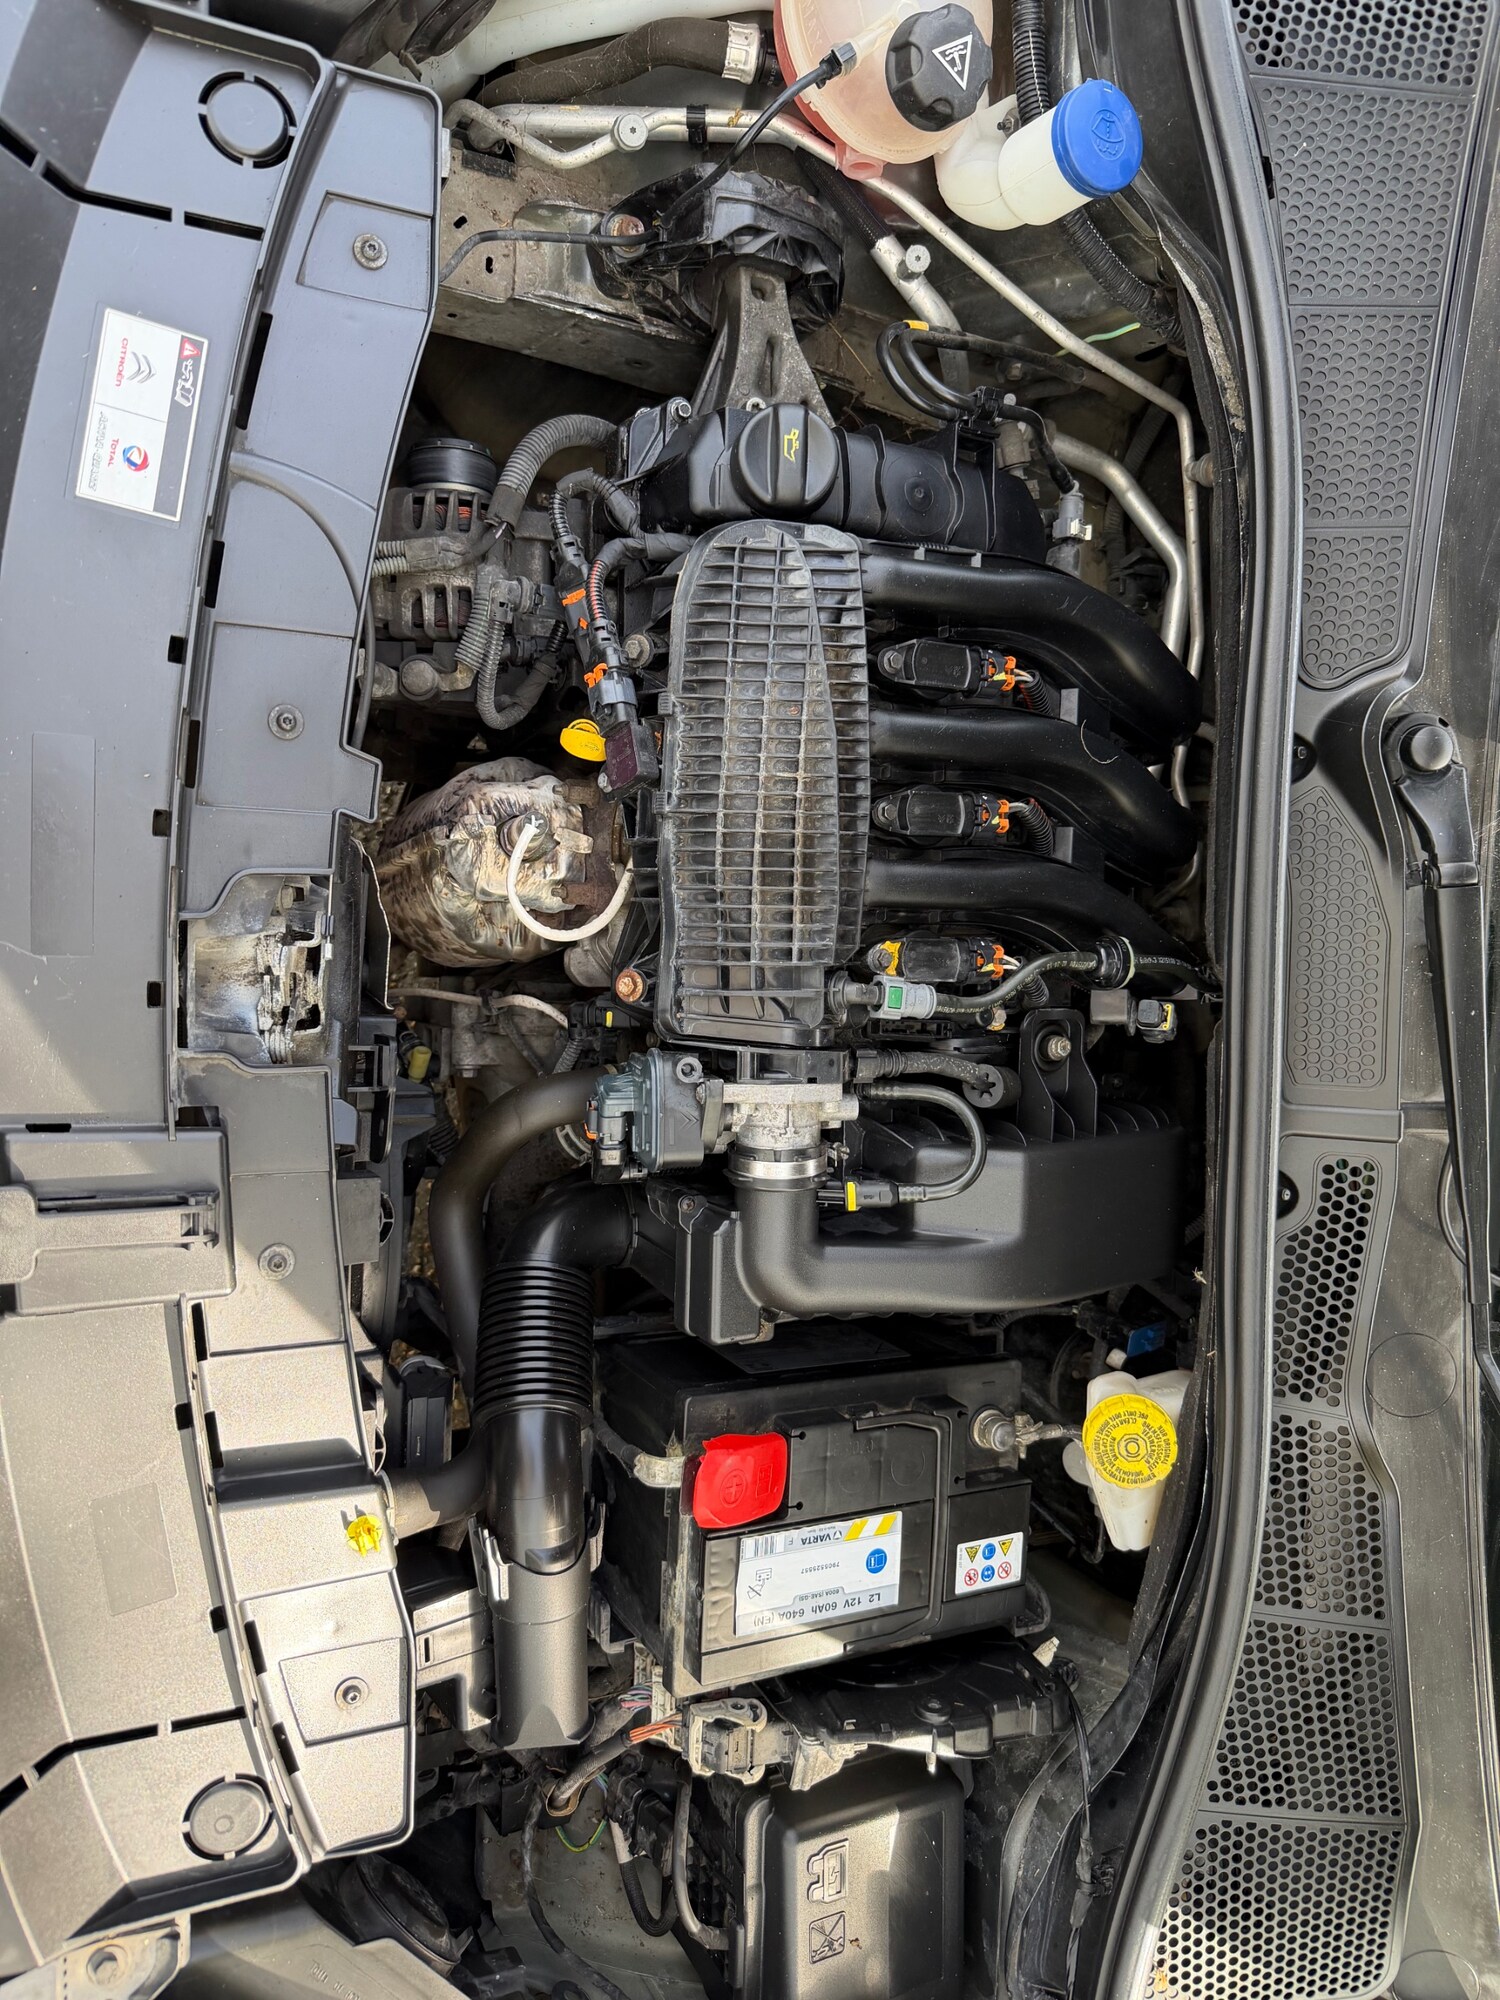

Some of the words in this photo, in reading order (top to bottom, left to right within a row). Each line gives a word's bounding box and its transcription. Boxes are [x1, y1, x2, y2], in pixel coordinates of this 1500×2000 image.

[107, 438, 120, 467] TOTAL
[1119, 1418, 1137, 1426] CLEAN
[1138, 1411, 1149, 1420] USE
[1103, 1421, 1119, 1437] FILLER
[1160, 1438, 1171, 1465] ORIGINAL
[1102, 1449, 1116, 1469] BEFORE
[1114, 1466, 1144, 1477] REMOVING
[788, 1537, 794, 1545] F
[801, 1532, 832, 1545] VARTA
[843, 1596, 862, 1609] 12V
[868, 1592, 881, 1603] L2
[811, 1601, 838, 1615] 60Ah
[753, 1611, 775, 1627] (EN)
[778, 1608, 805, 1622] 640A
